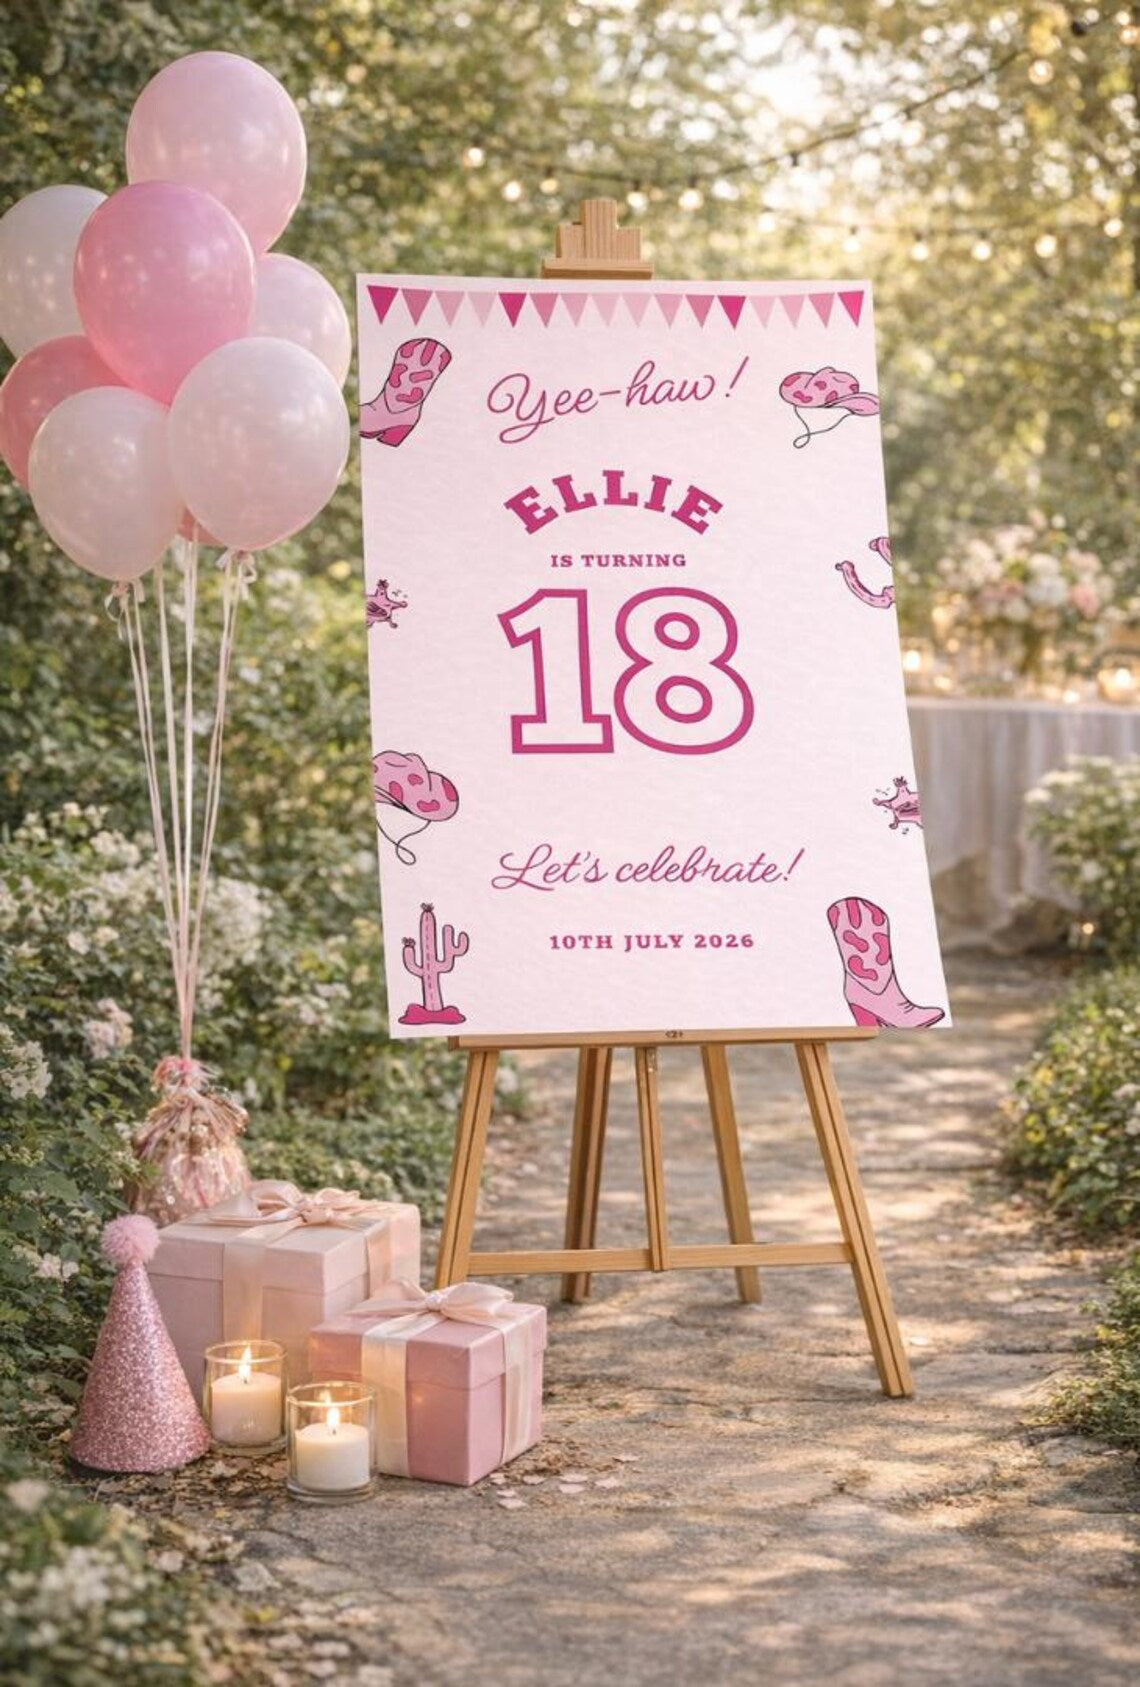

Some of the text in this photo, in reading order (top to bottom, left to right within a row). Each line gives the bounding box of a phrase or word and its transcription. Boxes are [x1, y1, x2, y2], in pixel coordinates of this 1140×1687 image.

[503, 469, 724, 535] ELLIE
[550, 554, 687, 568] IS TURNING
[497, 587, 756, 756] 18
[491, 843, 806, 891] Let's celebrate!
[549, 934, 755, 953] 10TH JULY 2026
